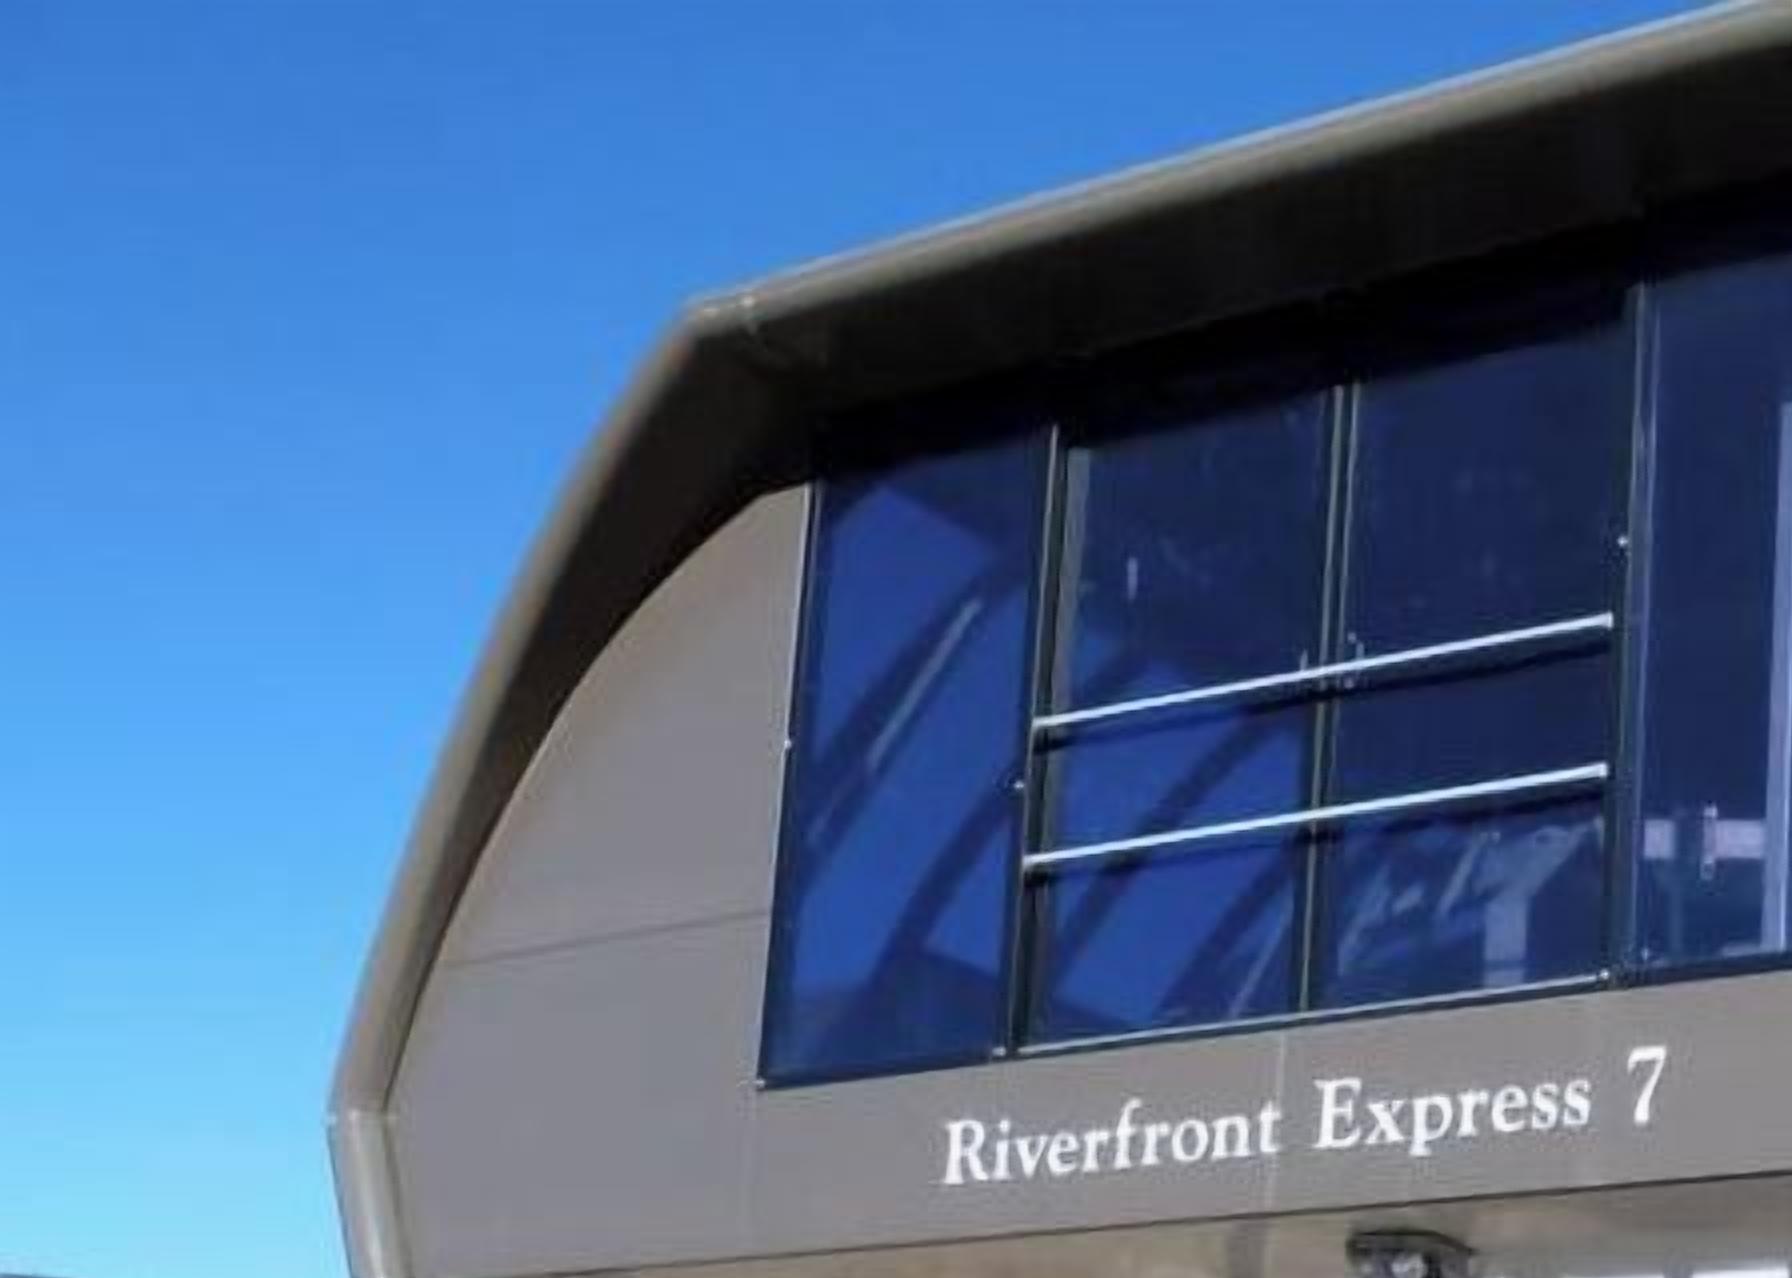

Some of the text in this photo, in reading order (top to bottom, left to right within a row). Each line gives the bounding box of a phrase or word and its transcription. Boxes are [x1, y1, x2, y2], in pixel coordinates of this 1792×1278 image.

[942, 1045, 1667, 1186] Riverfront Express 7
